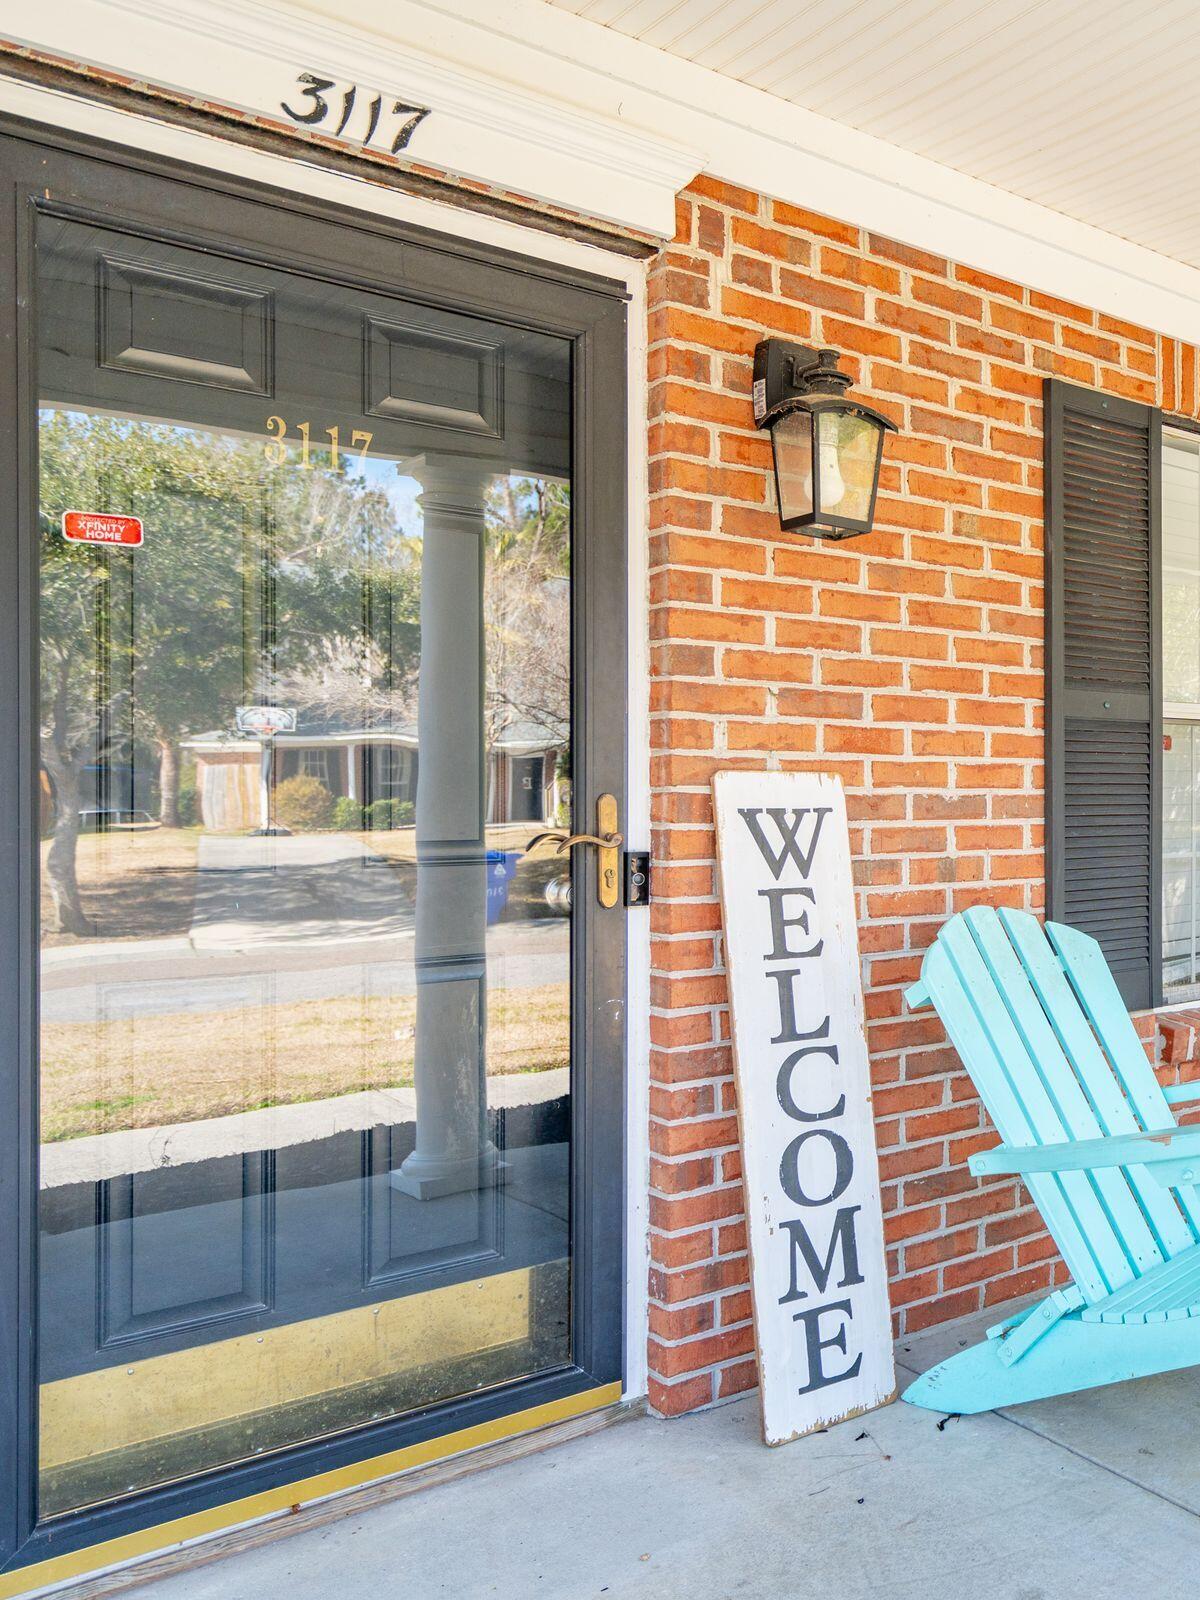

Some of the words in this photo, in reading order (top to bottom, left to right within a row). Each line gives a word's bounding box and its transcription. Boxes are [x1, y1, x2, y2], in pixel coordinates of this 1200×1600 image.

[281, 72, 432, 153] 3117
[264, 415, 374, 475] 3117
[78, 520, 126, 533] XFINITY
[81, 516, 116, 524] PROTECTED
[86, 530, 122, 541] HOME
[737, 807, 865, 1396] WELCOME
